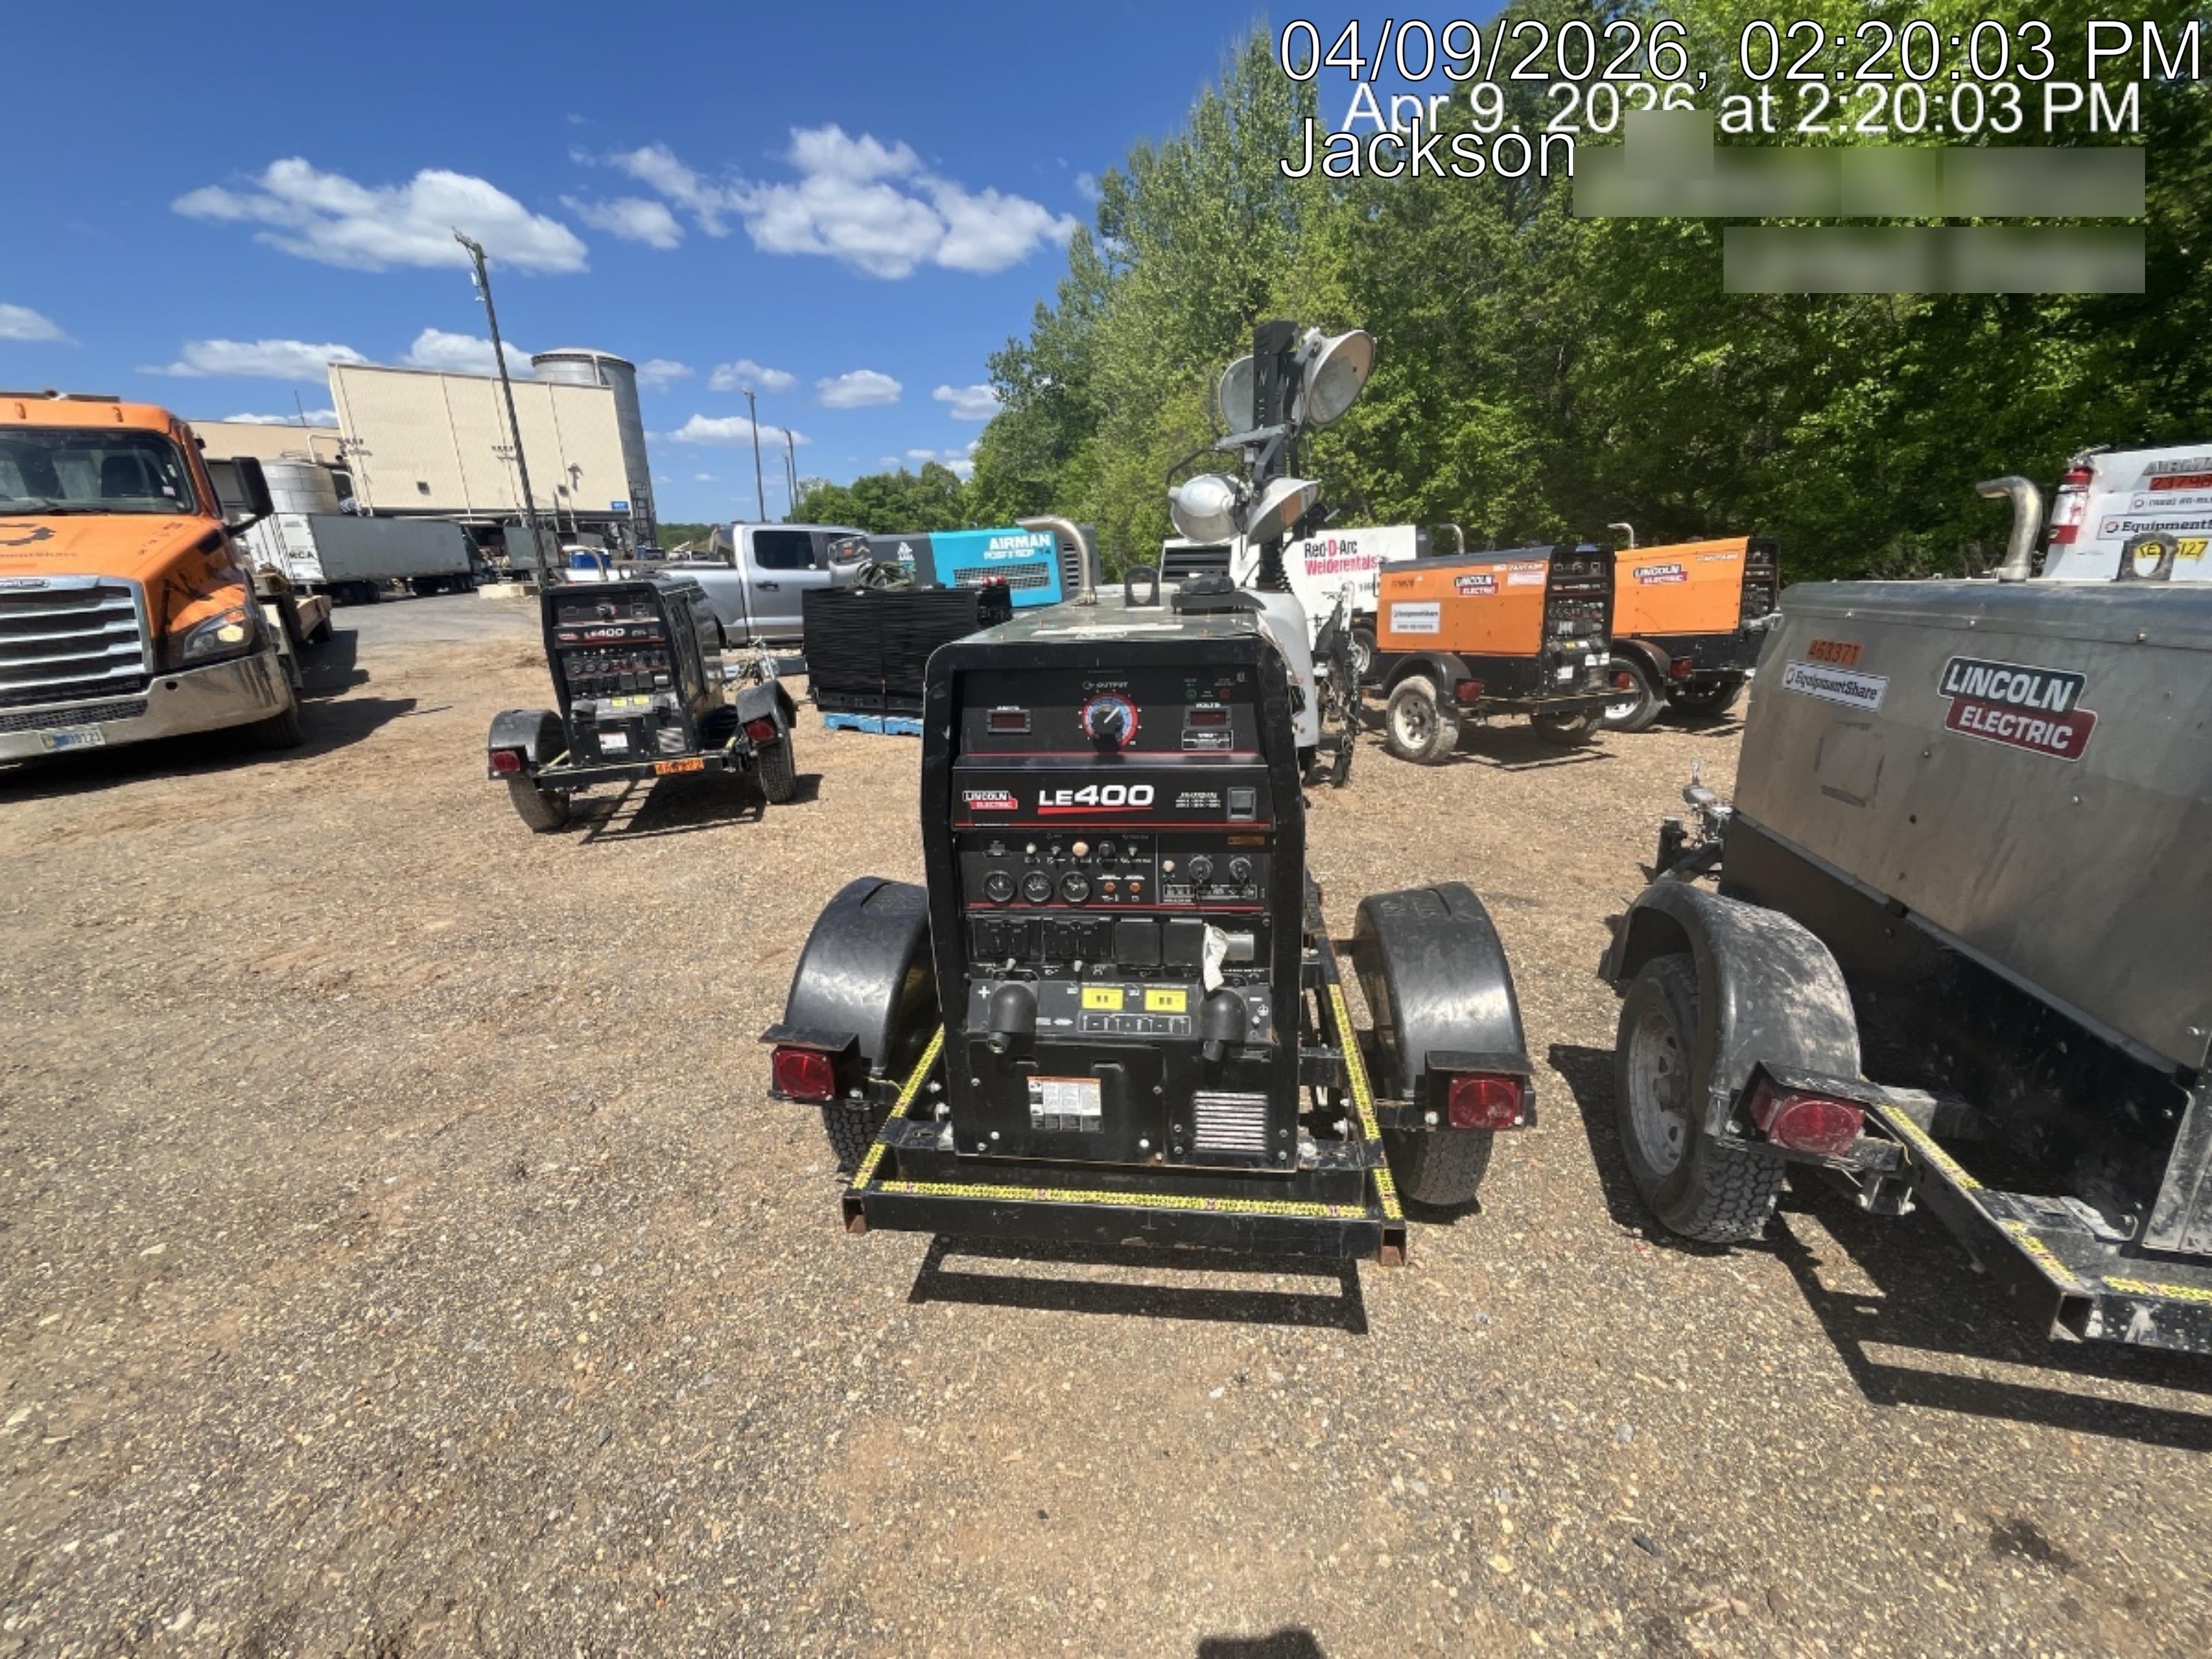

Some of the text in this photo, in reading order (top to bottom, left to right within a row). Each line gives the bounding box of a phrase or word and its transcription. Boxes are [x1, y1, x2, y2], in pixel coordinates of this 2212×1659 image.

[989, 534, 1051, 551] AIRMAN
[1304, 555, 1378, 575] Welderentals
[1808, 641, 1859, 665] 463371
[1795, 670, 1878, 700] EquipmentShare
[1945, 663, 2074, 712] LINCOLN
[1958, 705, 2073, 750] ELECTRIC
[966, 791, 1008, 801] LINCOLN
[1038, 784, 1155, 806] LE400
